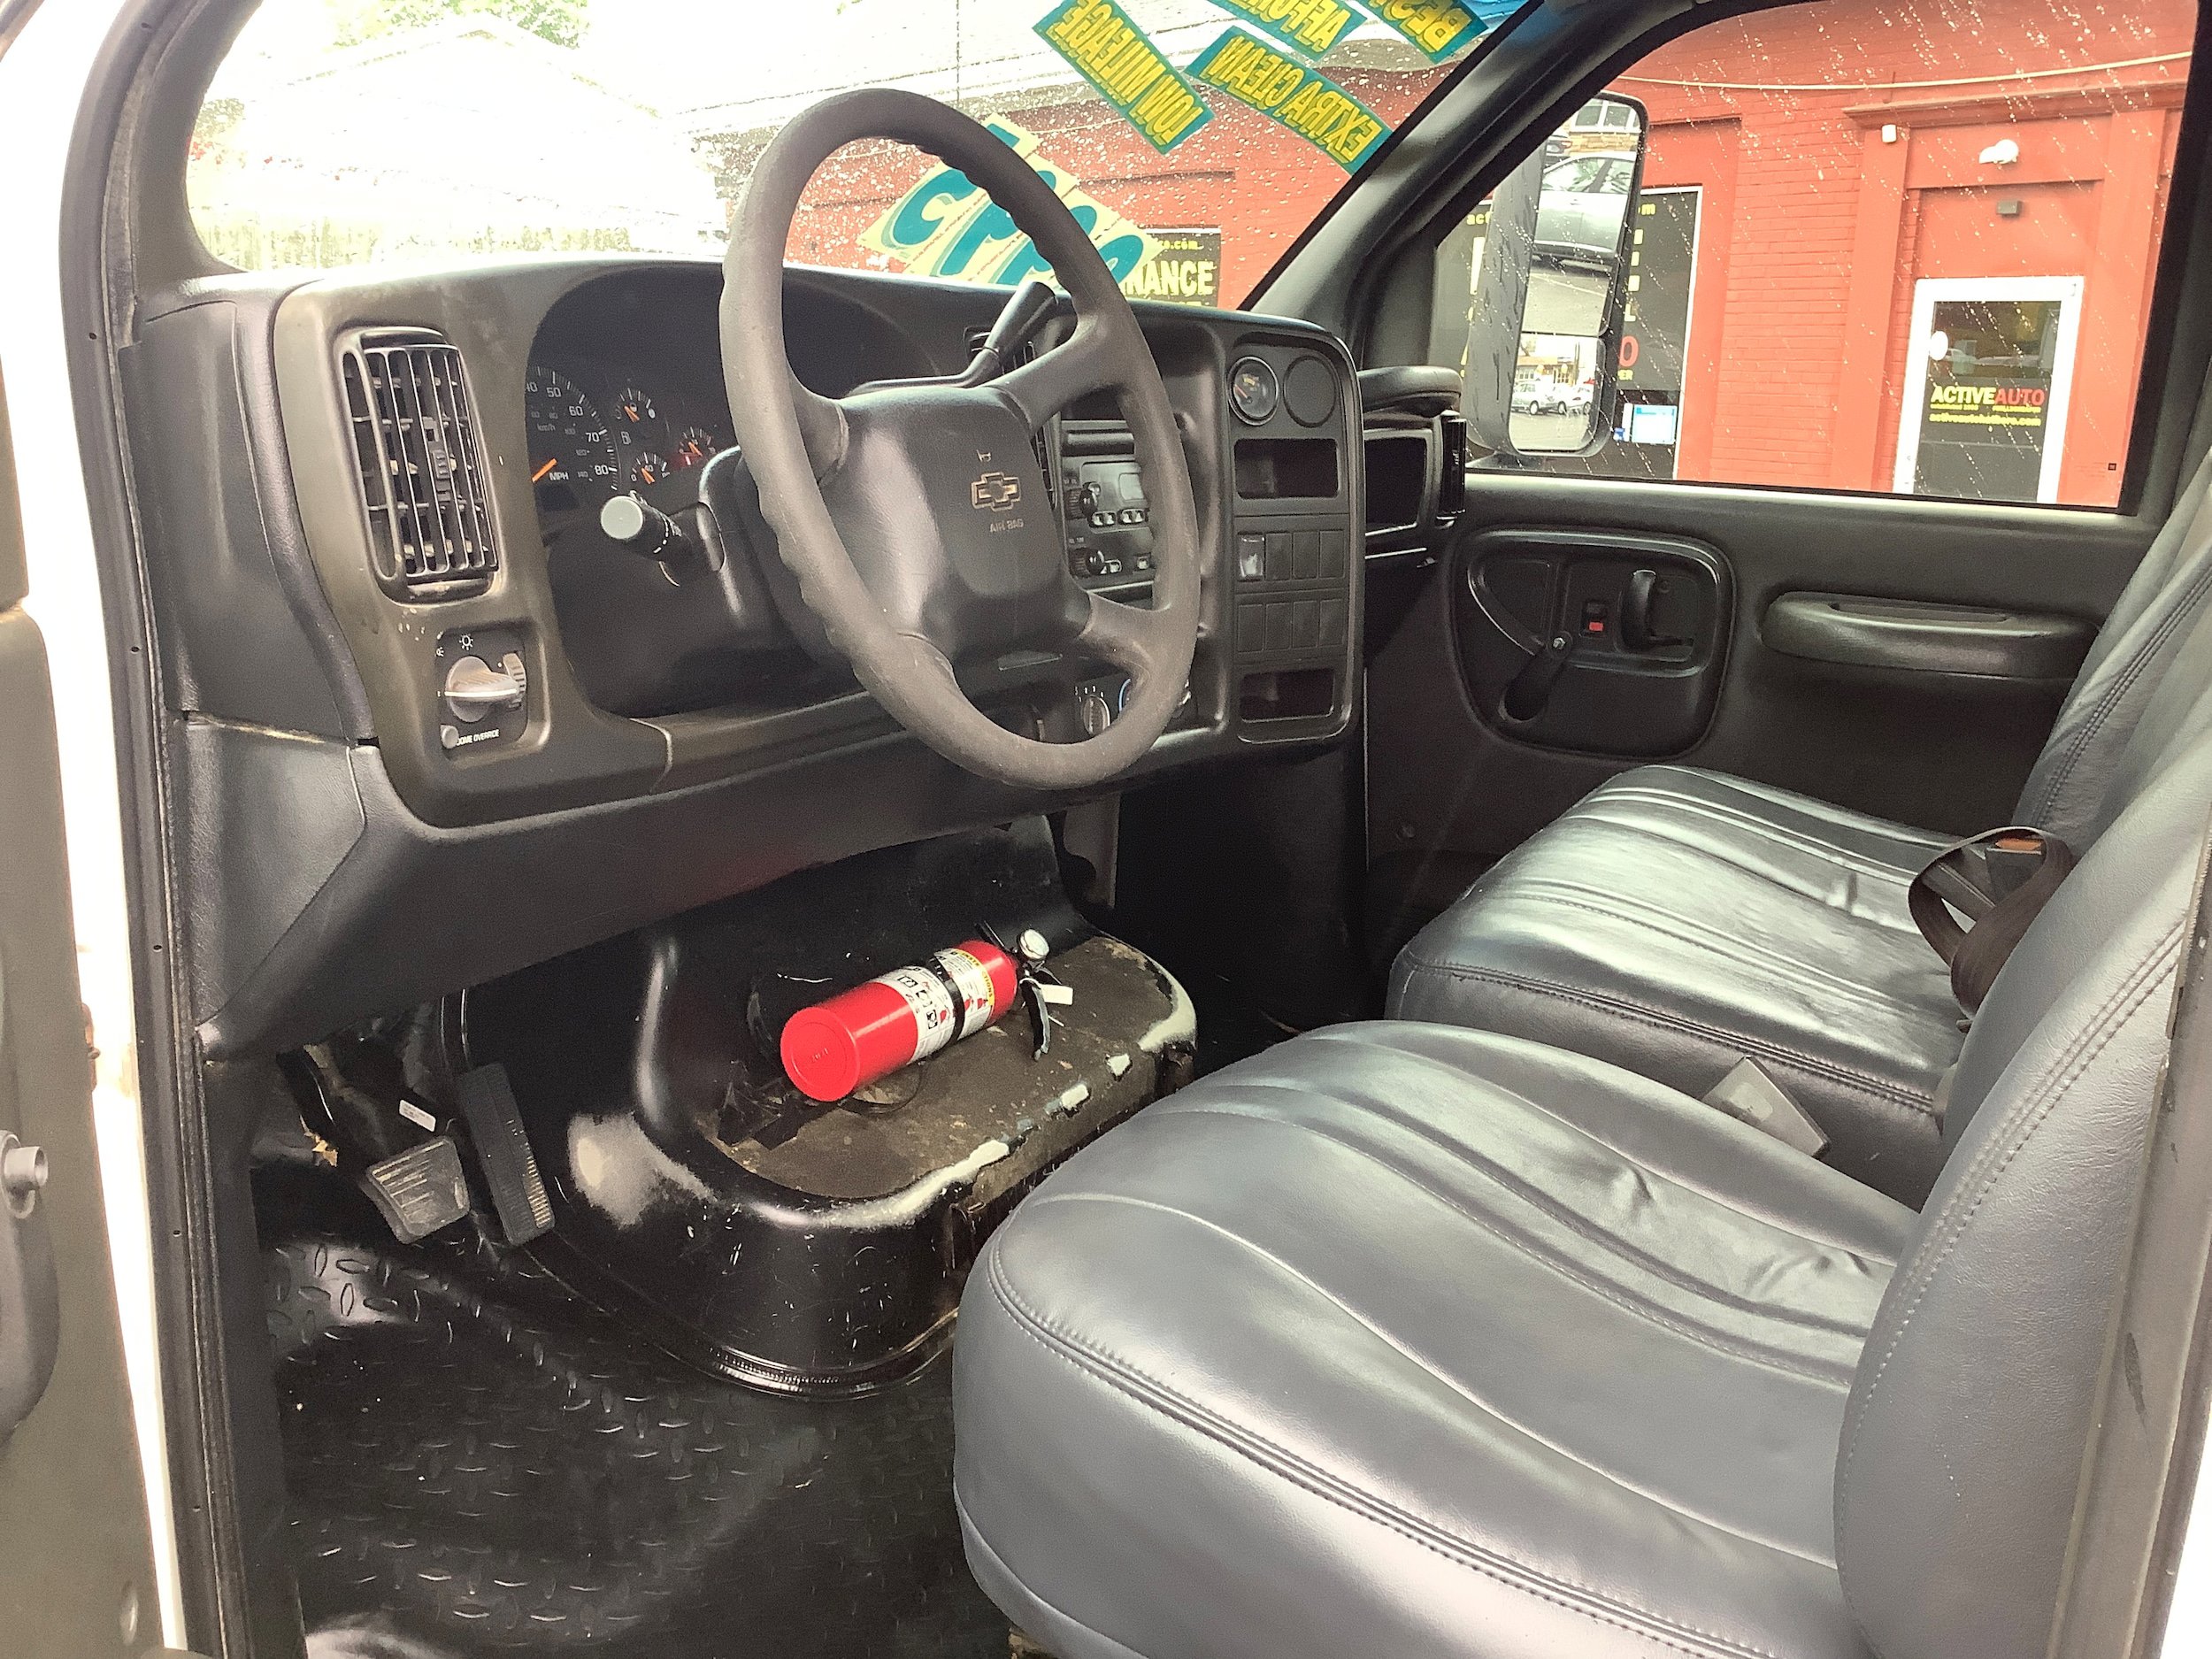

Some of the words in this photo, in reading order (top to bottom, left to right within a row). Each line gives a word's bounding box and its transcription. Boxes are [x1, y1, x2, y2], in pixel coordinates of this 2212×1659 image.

[546, 387, 561, 397] 50
[1930, 385, 2045, 405] ACTIVEAUTO
[568, 405, 584, 416] 60
[585, 431, 600, 442] 70
[594, 465, 610, 475] 80
[549, 472, 569, 480] MPH
[989, 520, 1006, 533] AIR
[1007, 518, 1025, 530] BAG
[472, 728, 500, 742] OVERRIDE
